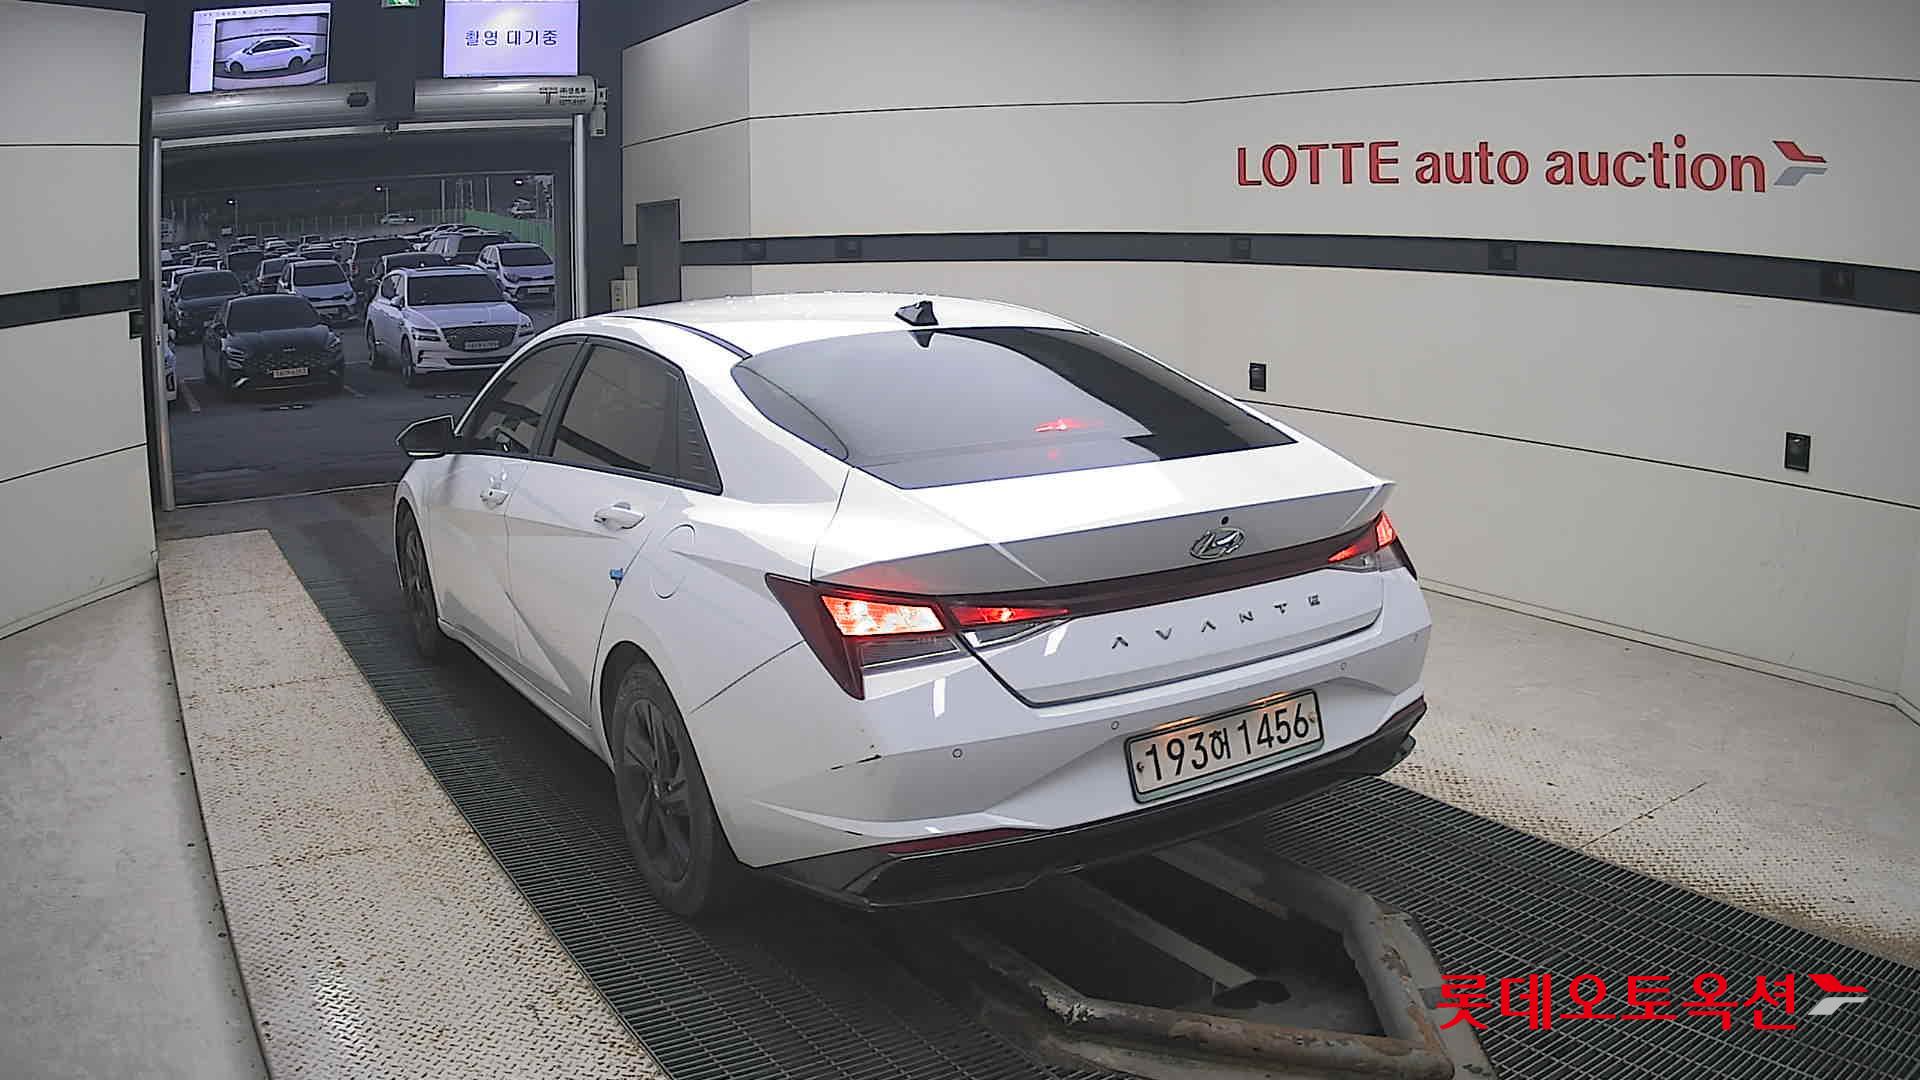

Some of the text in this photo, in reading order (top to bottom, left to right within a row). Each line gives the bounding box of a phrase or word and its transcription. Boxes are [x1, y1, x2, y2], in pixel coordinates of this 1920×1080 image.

[506, 29, 558, 47] 대기중
[1238, 133, 1767, 193] LOTTE auto auction
[1111, 593, 1321, 650] AVANTE
[1145, 702, 1310, 781] 193허 1456
